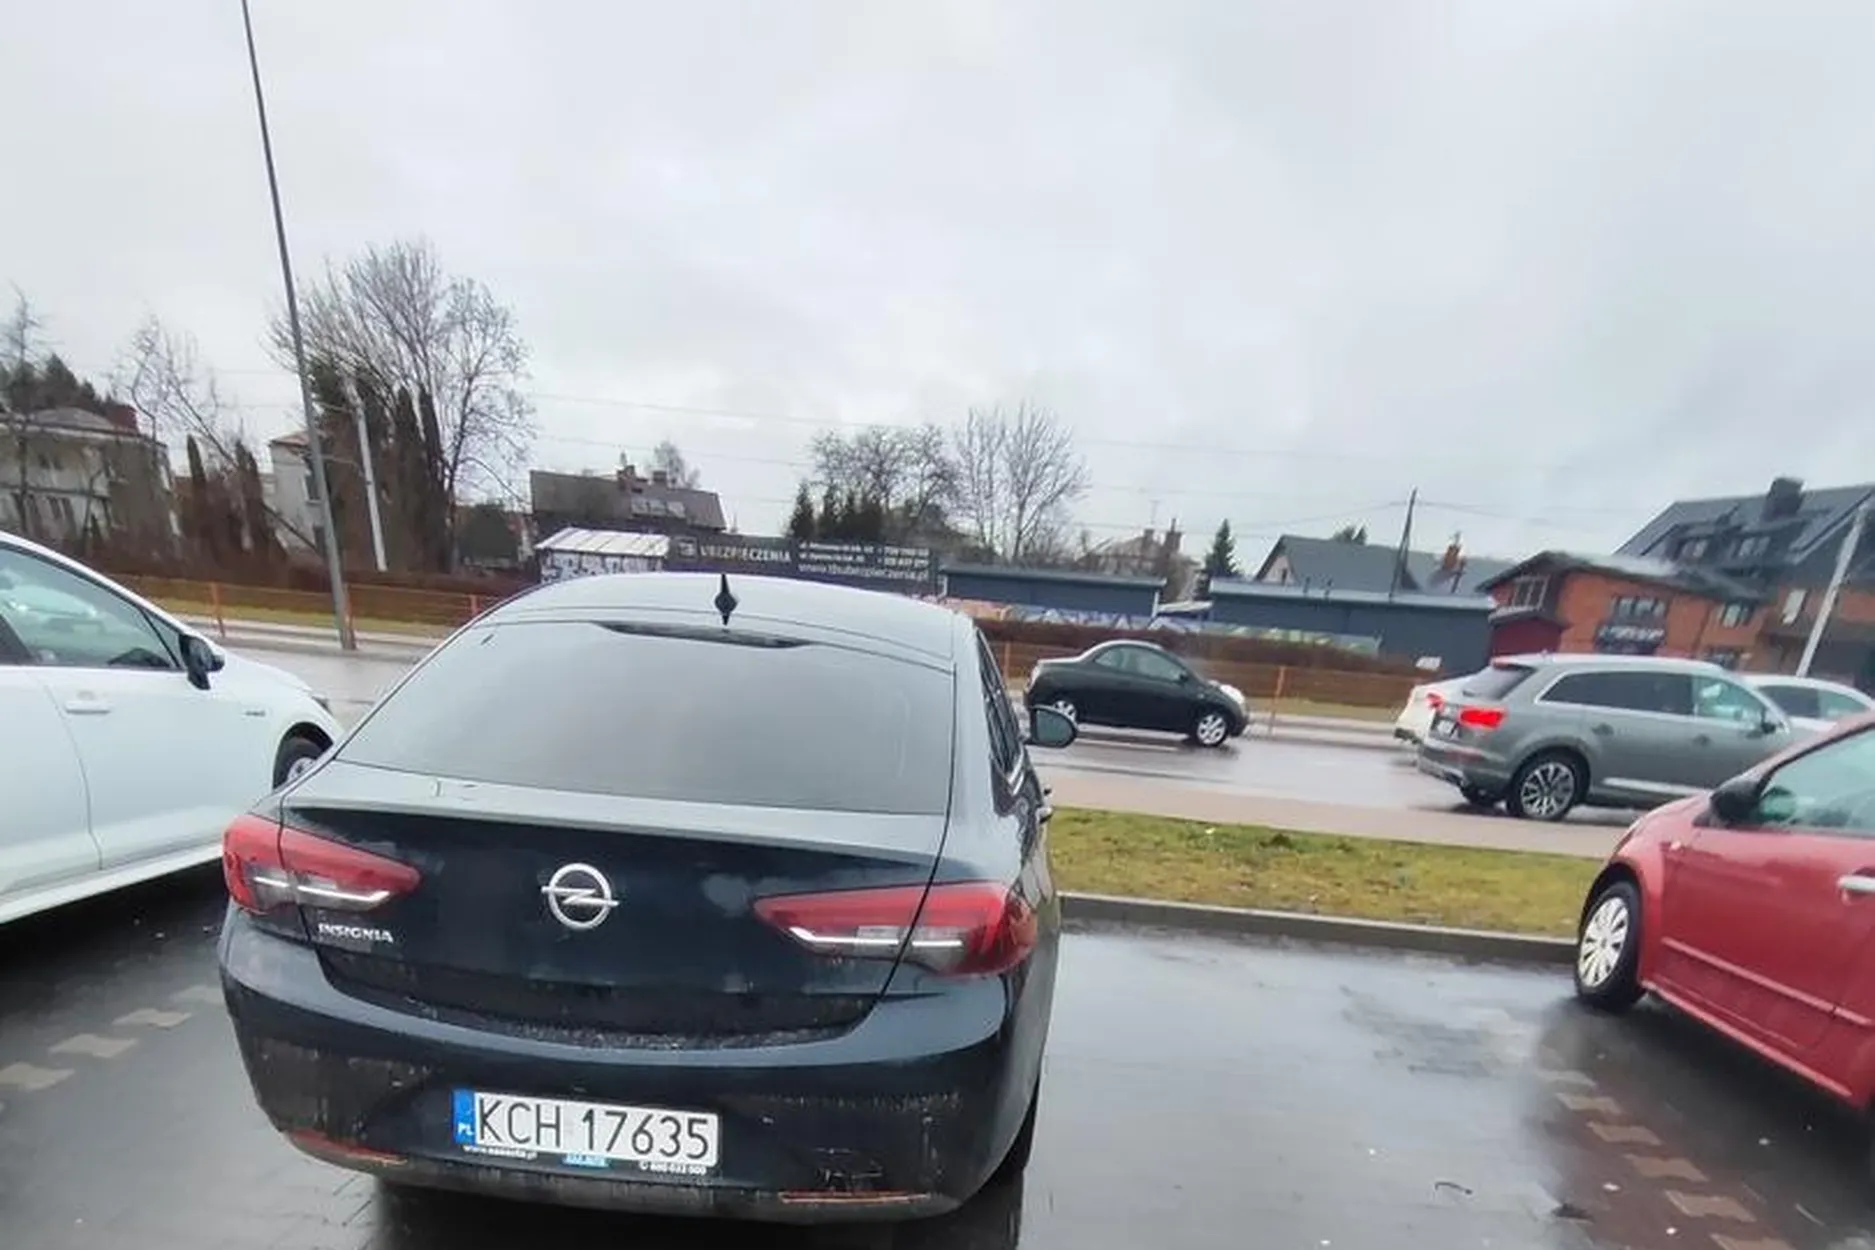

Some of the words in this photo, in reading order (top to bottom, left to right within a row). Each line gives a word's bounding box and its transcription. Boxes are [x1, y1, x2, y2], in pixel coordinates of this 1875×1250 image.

[318, 923, 394, 944] INSIGNIA
[479, 1098, 561, 1148] KCH
[582, 1107, 709, 1160] 17635
